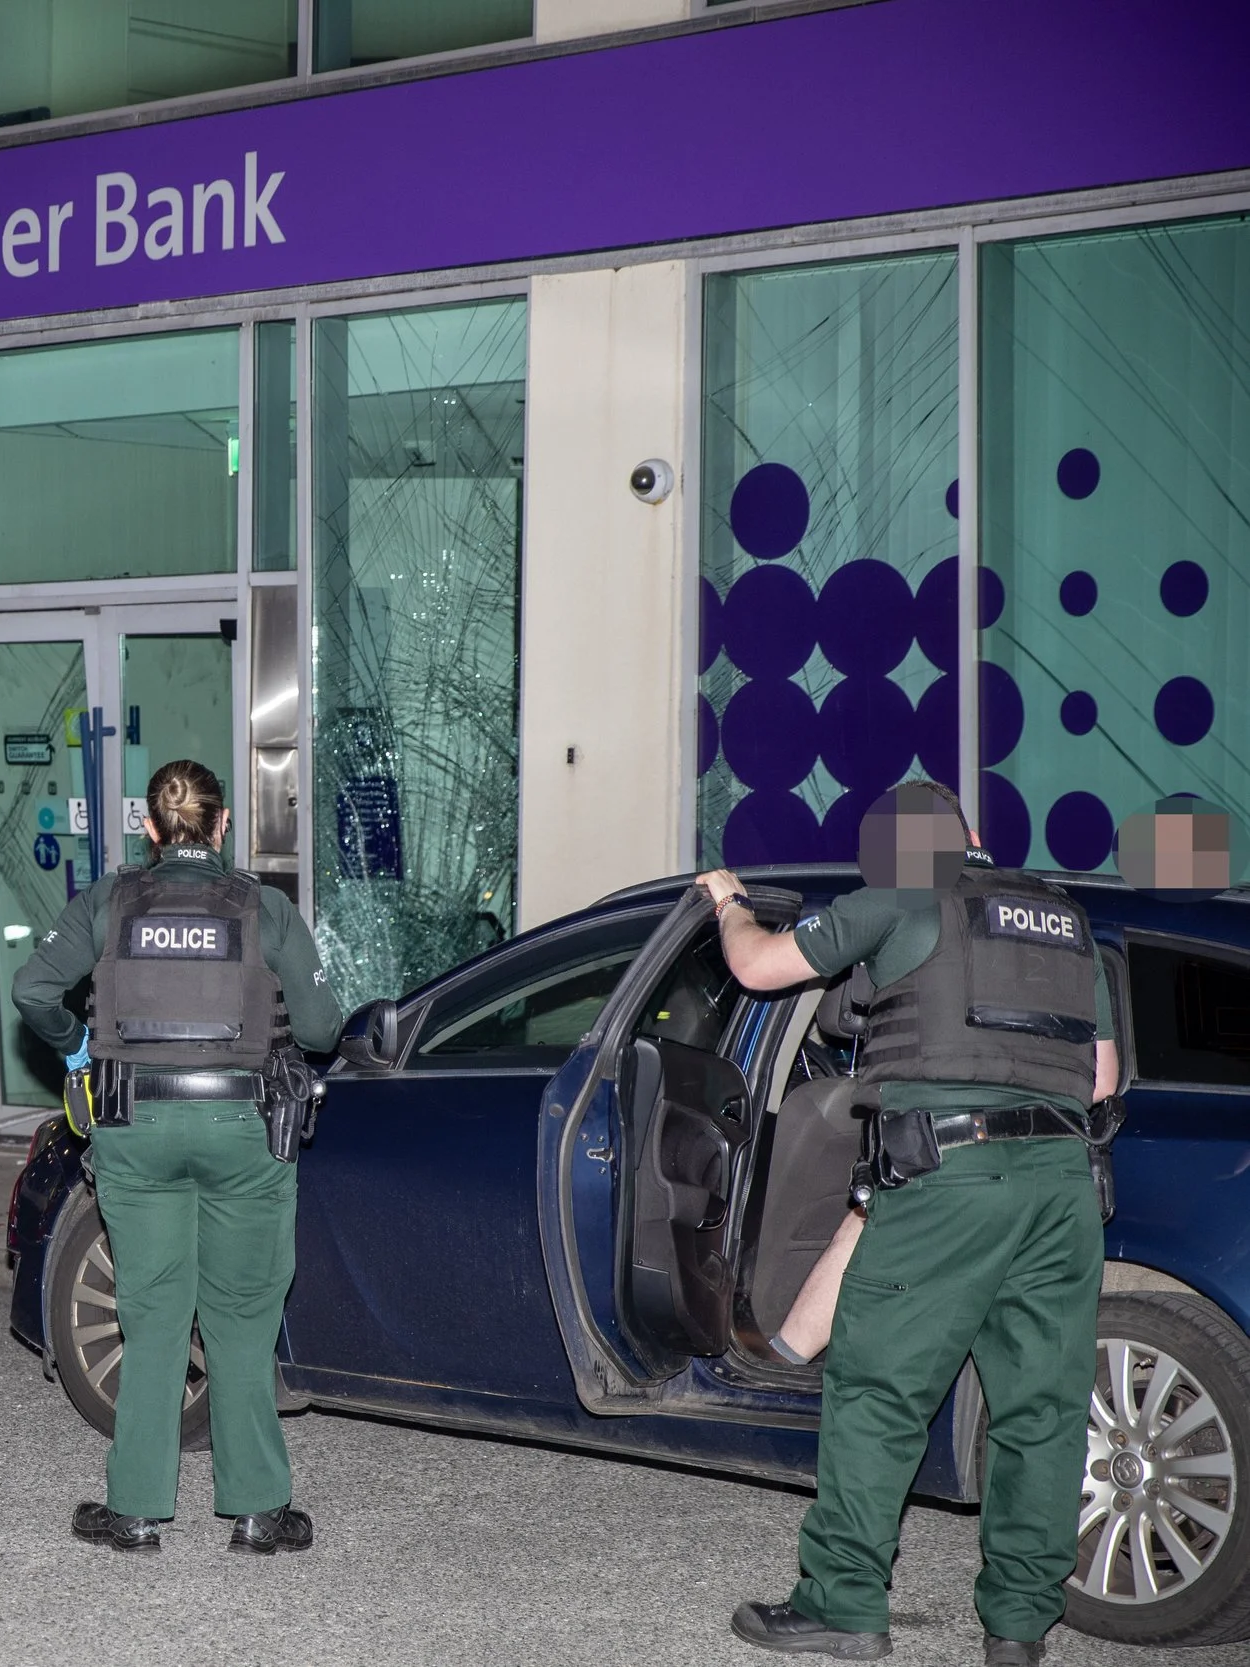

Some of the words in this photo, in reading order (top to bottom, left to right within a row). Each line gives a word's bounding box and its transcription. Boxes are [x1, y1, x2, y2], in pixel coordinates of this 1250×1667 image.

[95, 151, 286, 267] Bank
[177, 849, 208, 859] POLICE
[998, 905, 1074, 938] POLICE
[141, 927, 216, 949] POLICE
